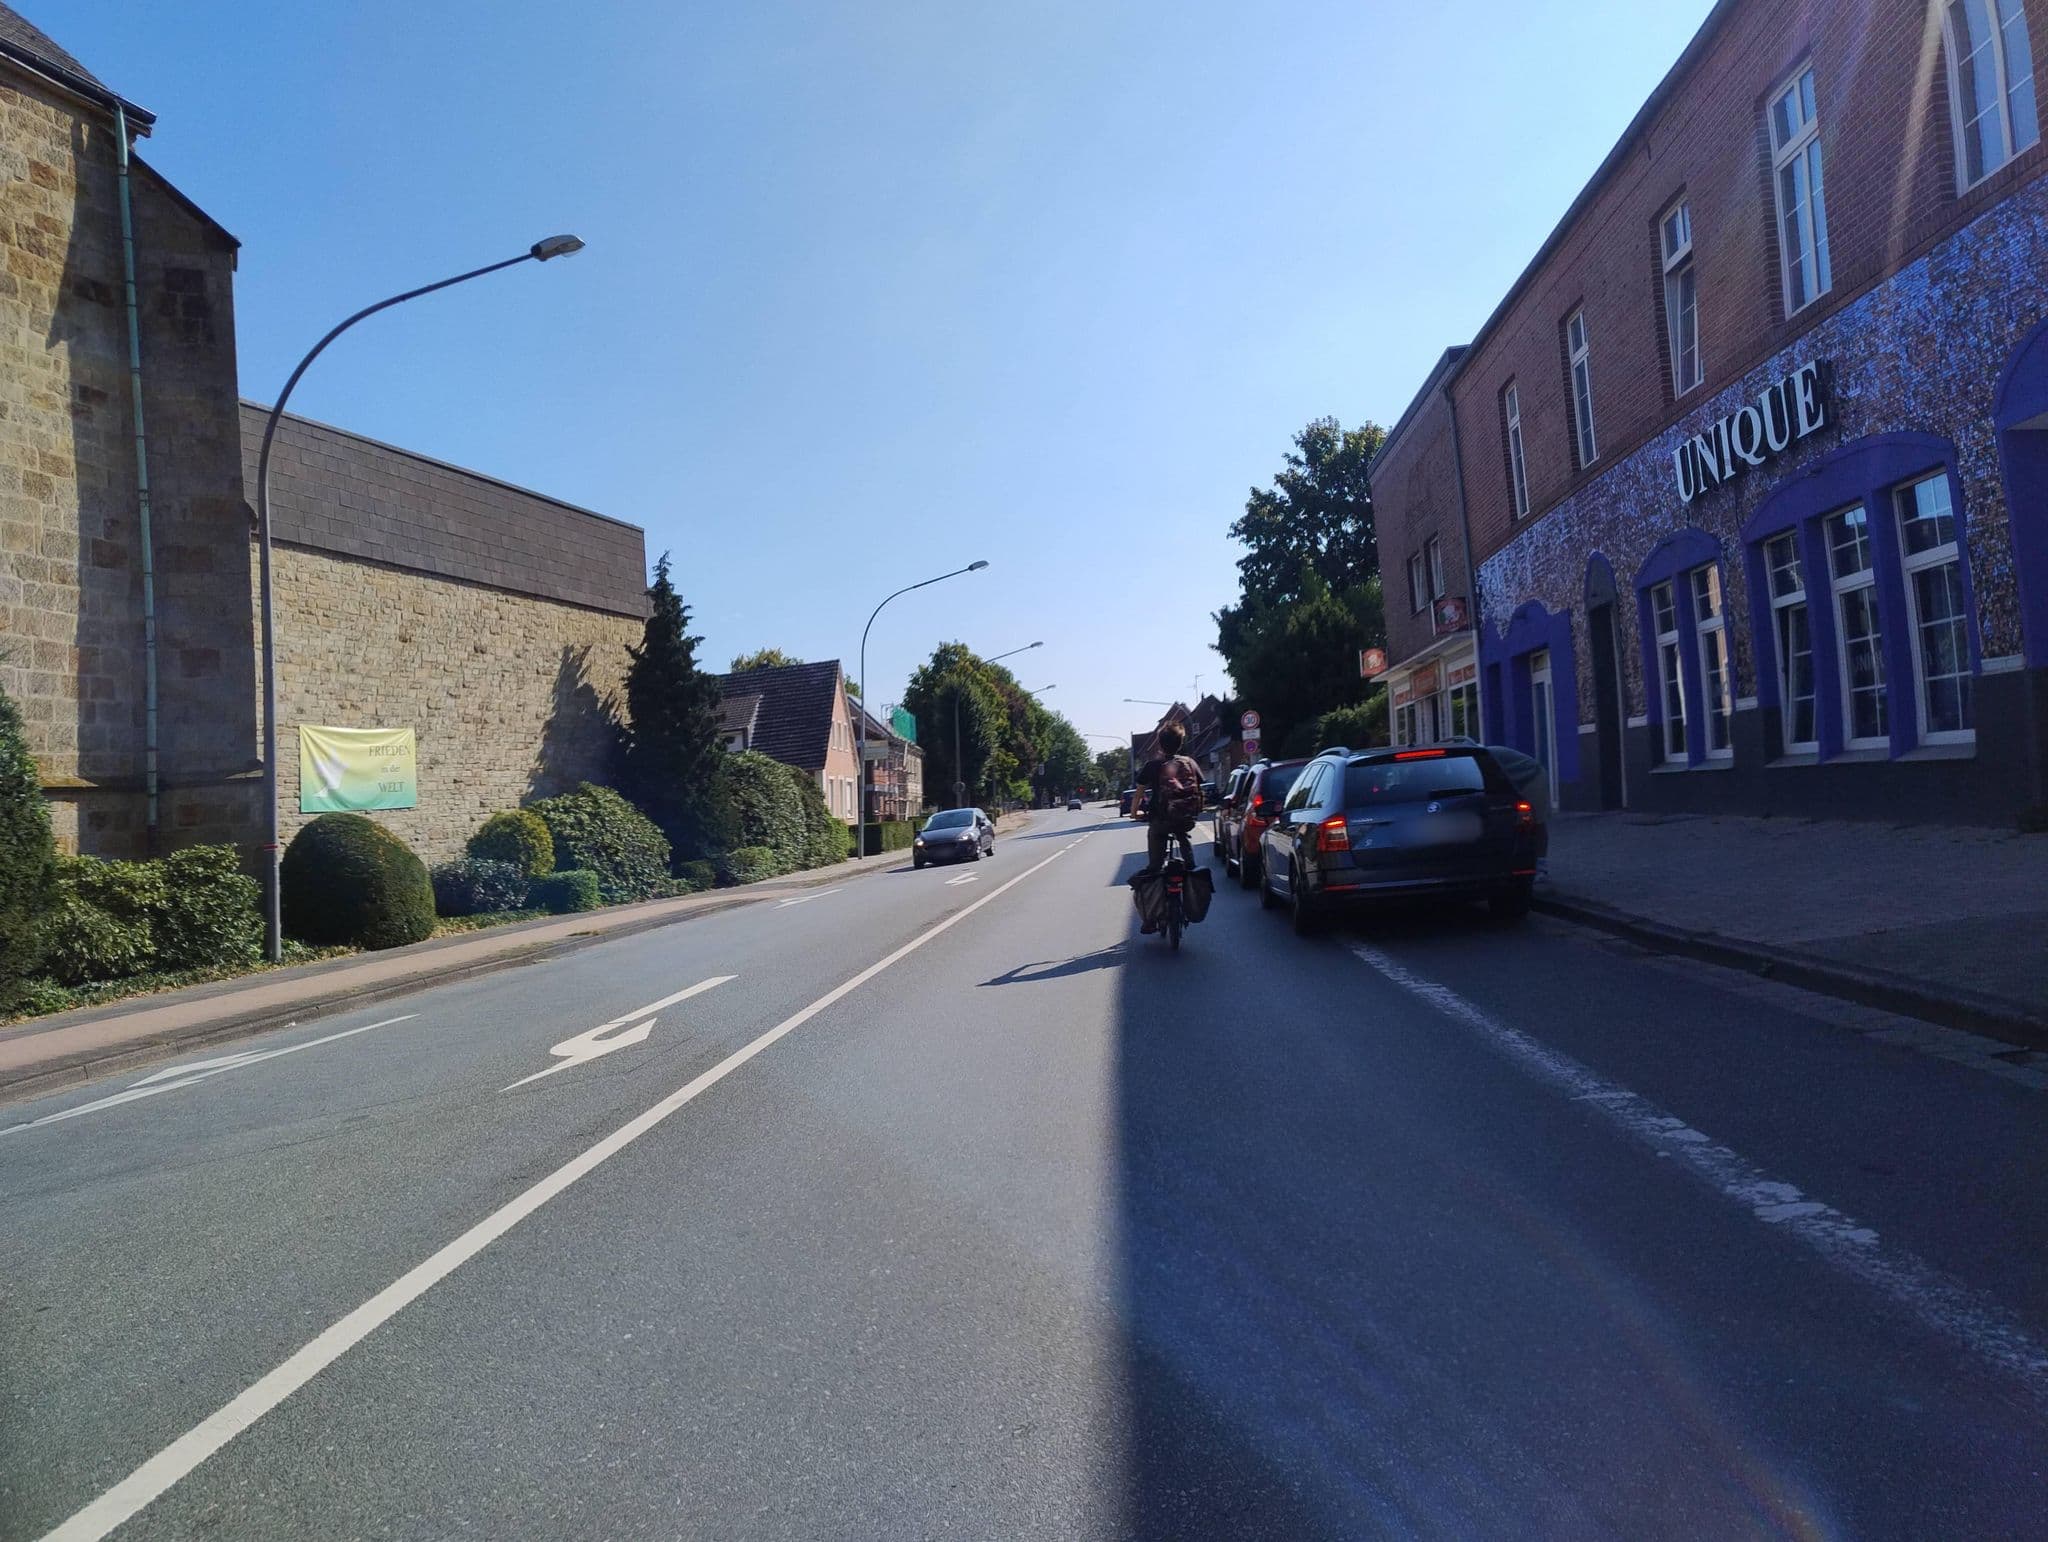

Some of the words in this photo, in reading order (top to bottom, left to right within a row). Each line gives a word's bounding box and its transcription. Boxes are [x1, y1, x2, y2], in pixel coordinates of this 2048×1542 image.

[1672, 359, 1824, 503] UNIQUE
[369, 745, 412, 756] FRIEDEN
[378, 782, 404, 793] WELT
